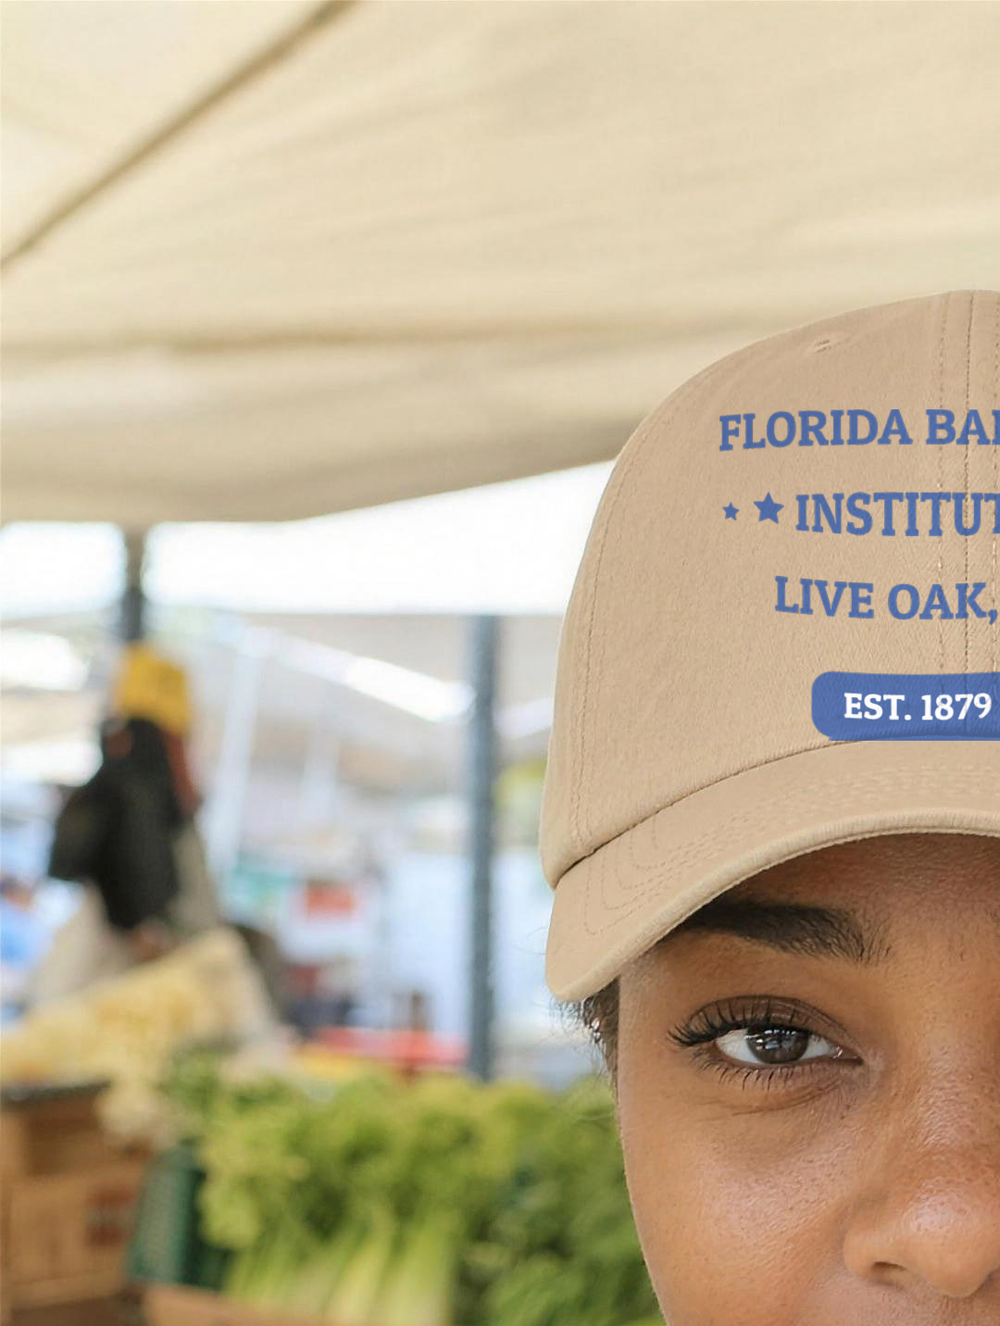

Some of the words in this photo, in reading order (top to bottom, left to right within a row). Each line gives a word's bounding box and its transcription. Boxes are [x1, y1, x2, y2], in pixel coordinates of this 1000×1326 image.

[719, 409, 913, 452] FLORIDA
[774, 575, 874, 619] LIVE
[887, 582, 999, 625] OAK,
[843, 692, 912, 721] EST.
[920, 692, 993, 721] 1879
